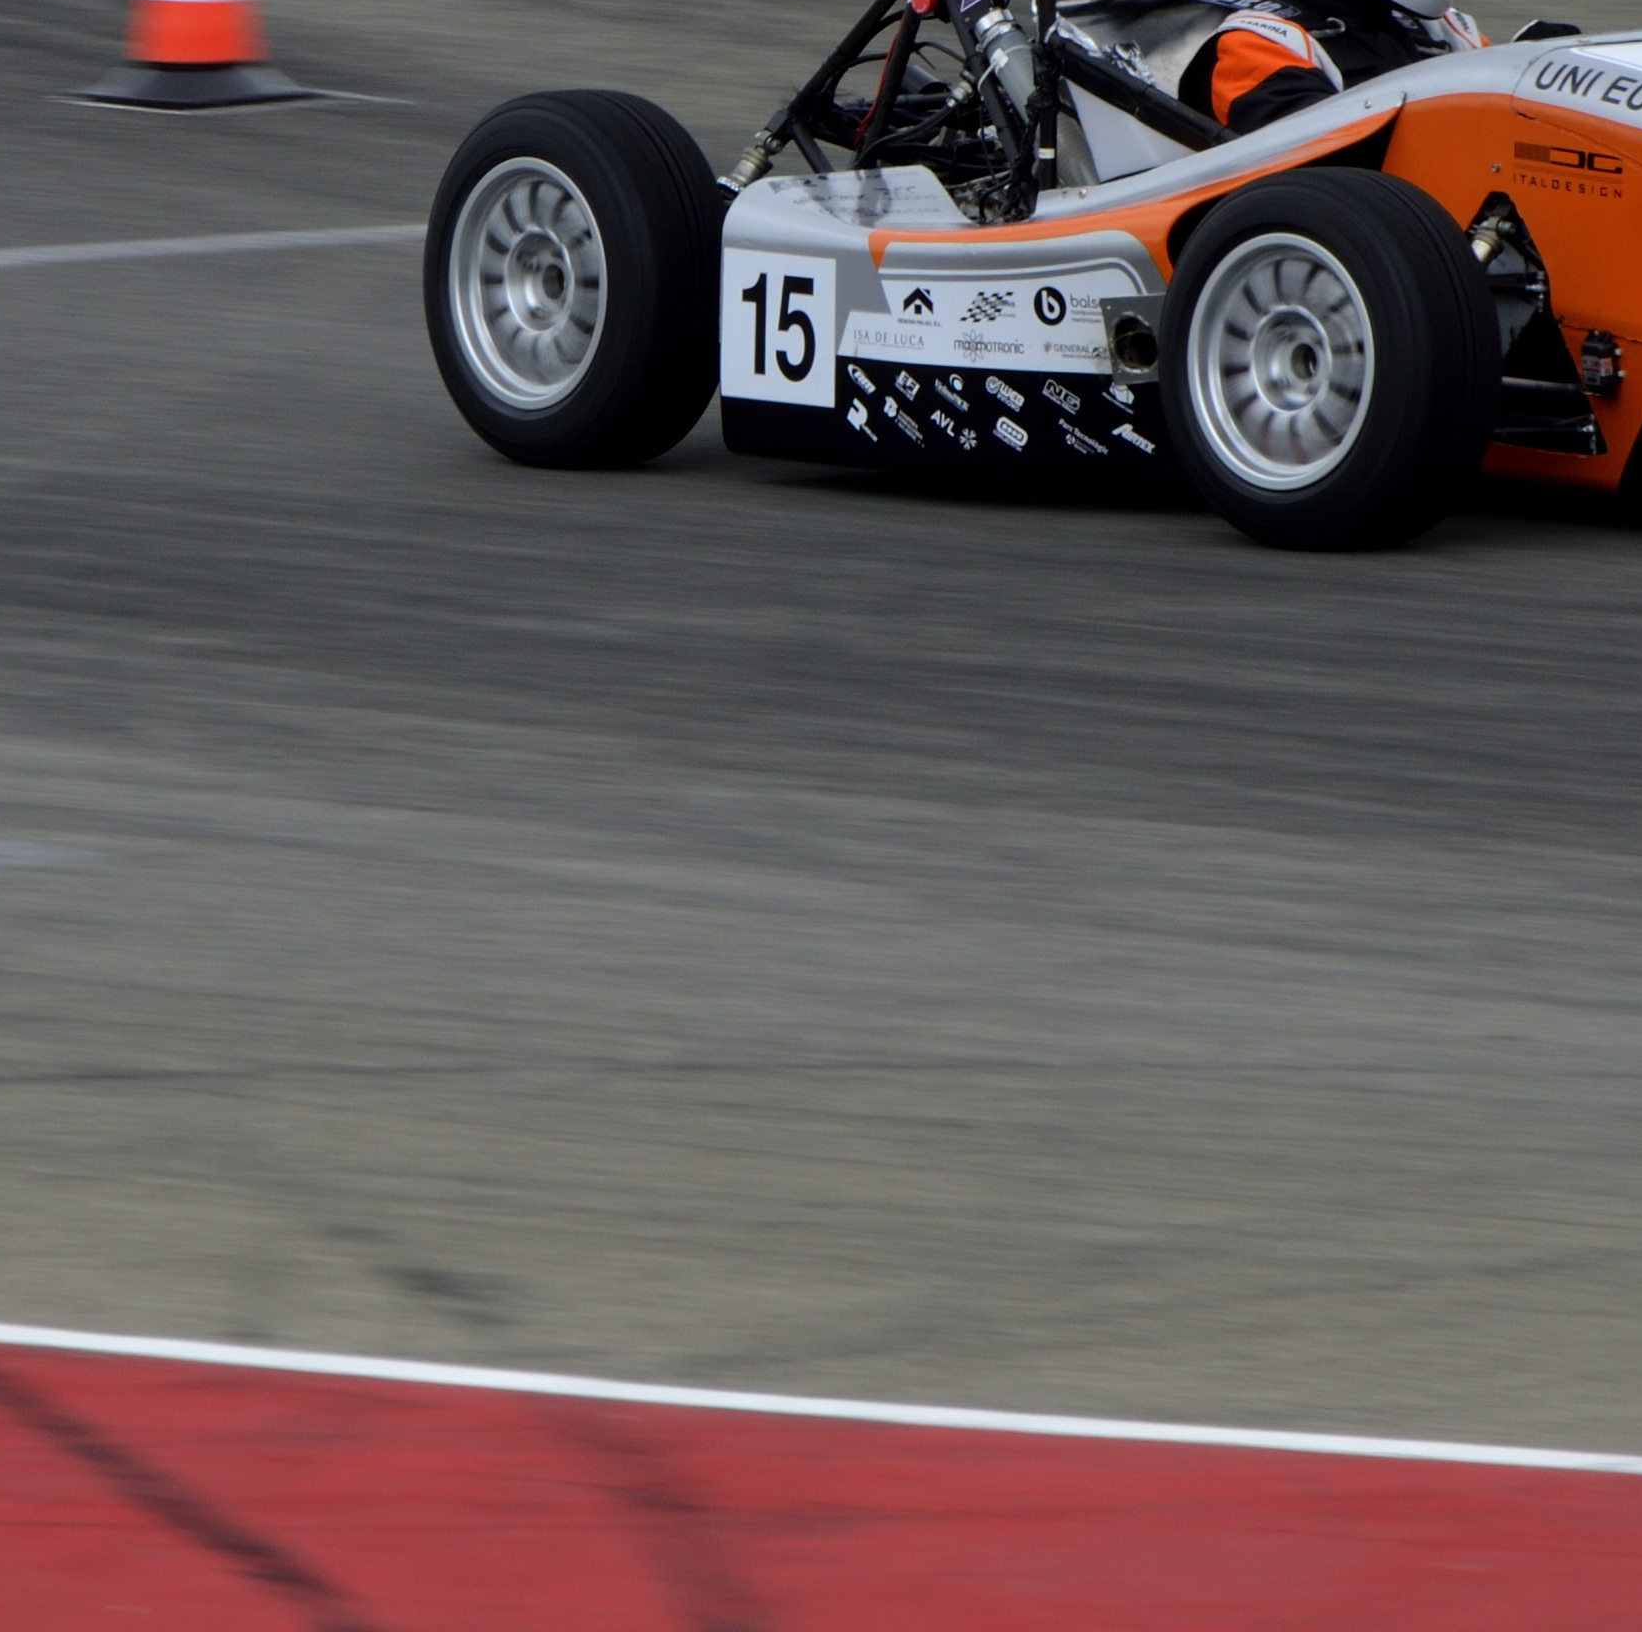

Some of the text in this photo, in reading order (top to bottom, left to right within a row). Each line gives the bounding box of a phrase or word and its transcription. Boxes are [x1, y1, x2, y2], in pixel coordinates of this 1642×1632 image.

[1535, 61, 1605, 97] UNI
[1513, 173, 1623, 199] ITALDESIGN
[741, 272, 817, 383] 15
[853, 329, 870, 342] ISA
[875, 331, 888, 343] DE
[894, 334, 924, 347] LUCA
[930, 409, 955, 437] AVL
